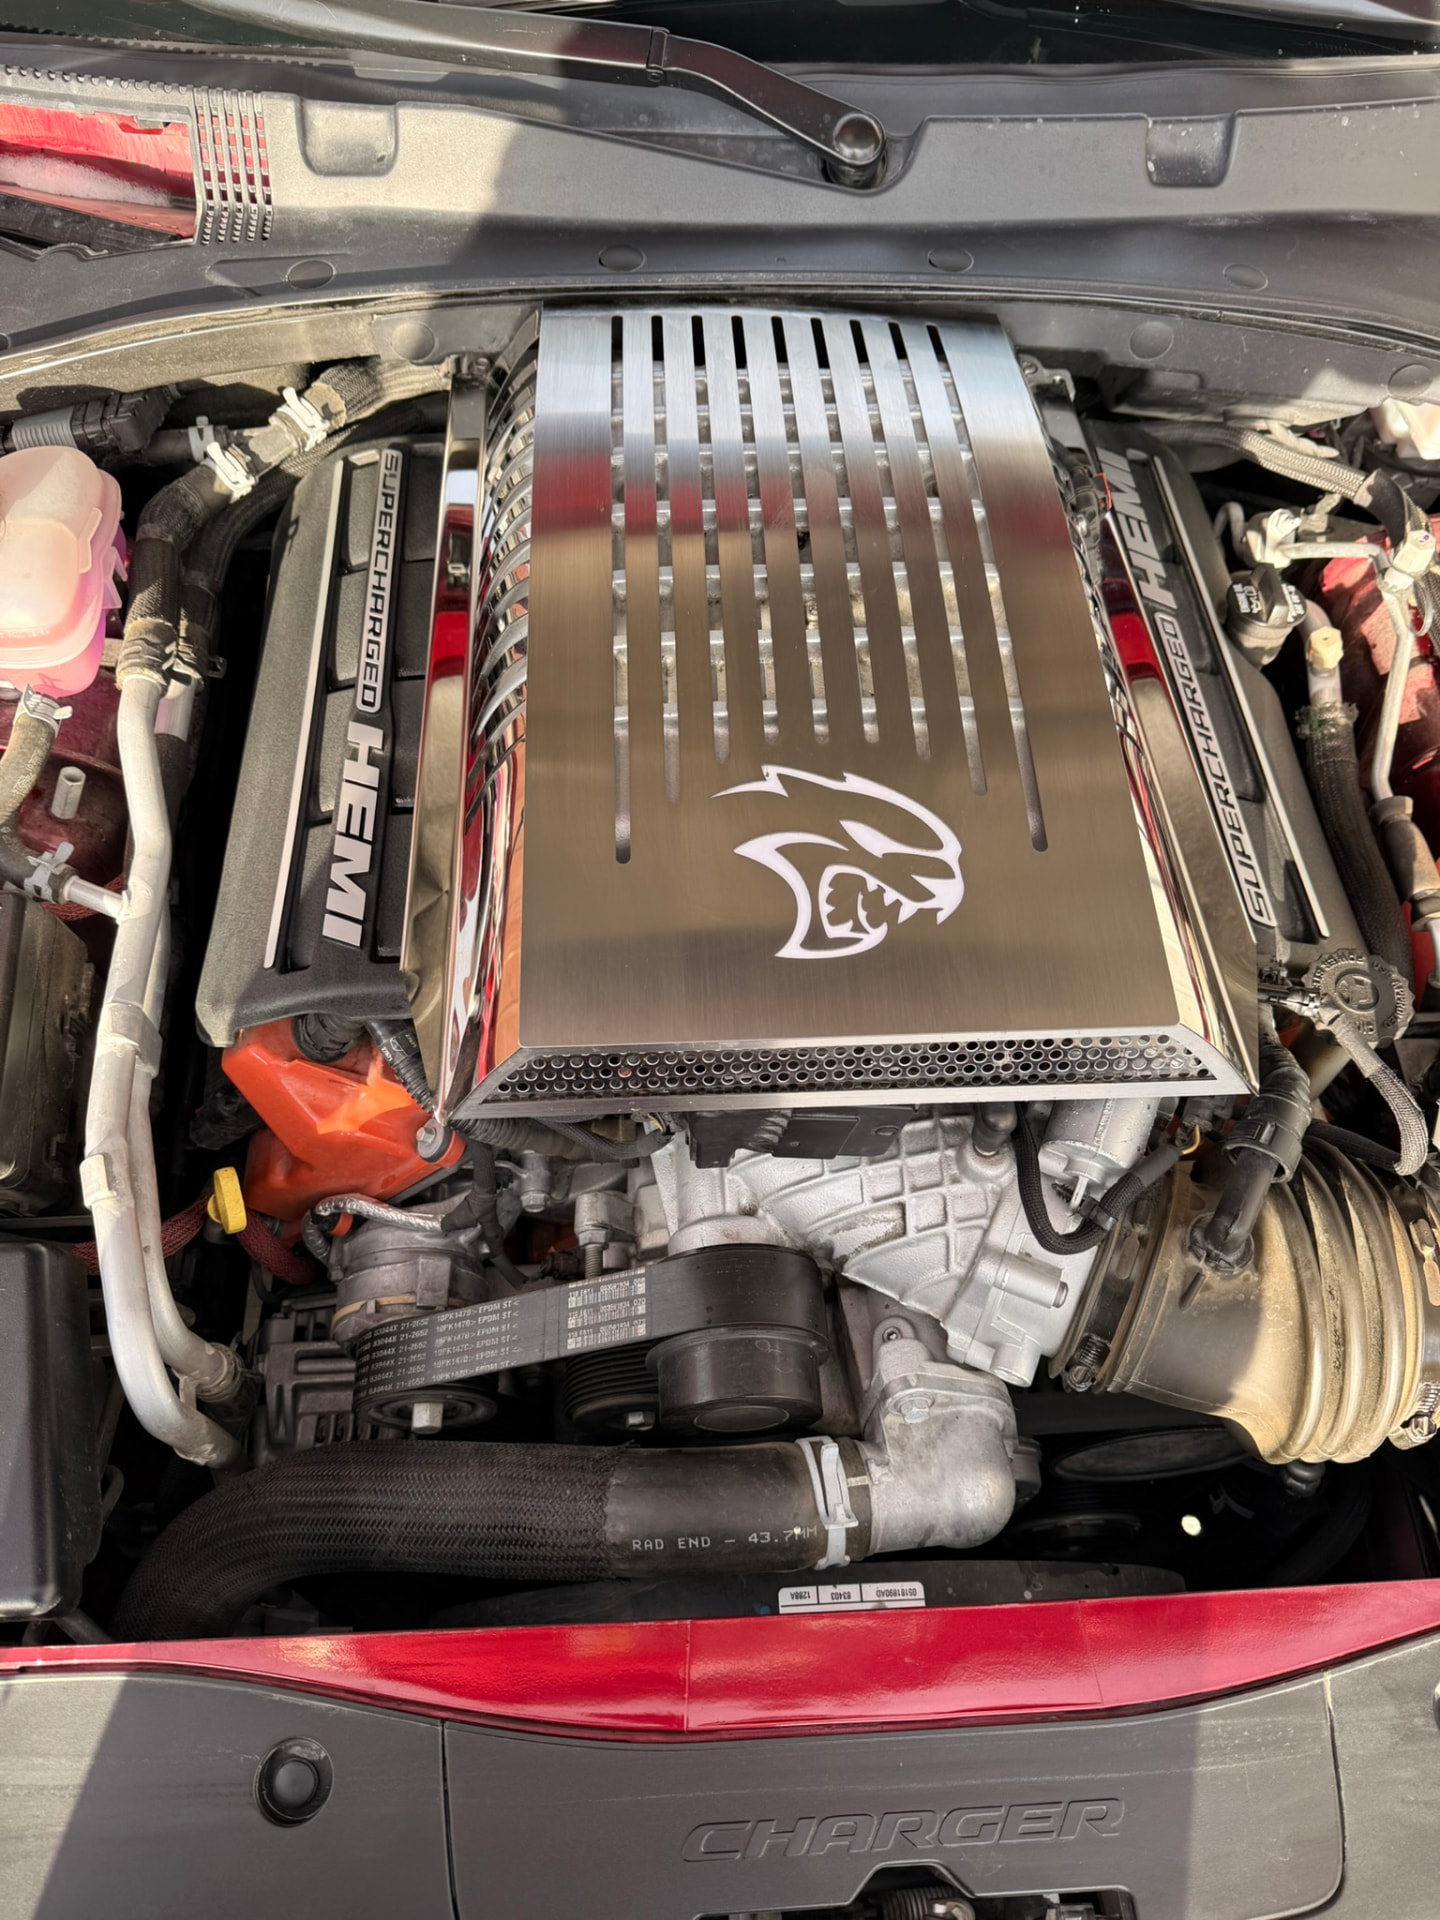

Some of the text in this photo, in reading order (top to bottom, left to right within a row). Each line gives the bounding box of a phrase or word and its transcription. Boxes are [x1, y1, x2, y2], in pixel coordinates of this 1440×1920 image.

[322, 452, 400, 948] SUPERCHARGED HEMI
[1096, 447, 1275, 918] SUPERCHARGED HEMI
[478, 1313, 500, 1325] EPDM
[631, 1538, 665, 1551] RAD
[677, 1536, 711, 1550] END
[681, 1797, 1125, 1862] CHARGER
